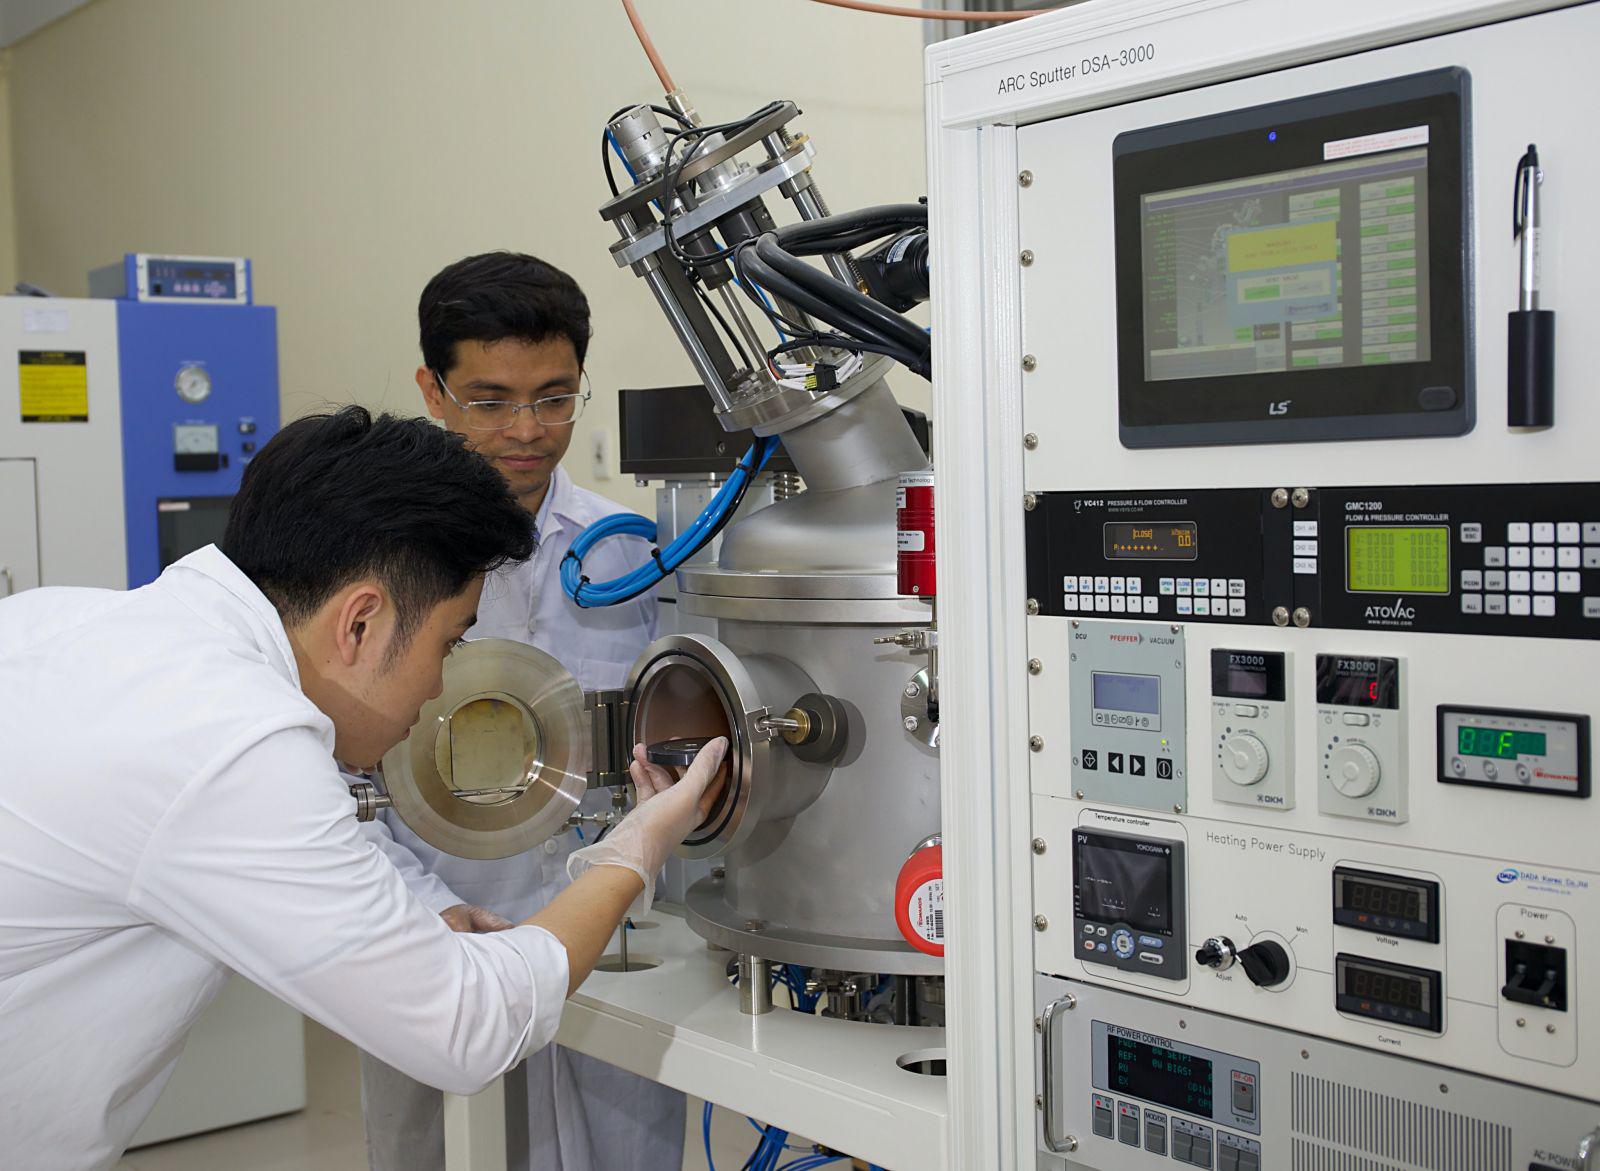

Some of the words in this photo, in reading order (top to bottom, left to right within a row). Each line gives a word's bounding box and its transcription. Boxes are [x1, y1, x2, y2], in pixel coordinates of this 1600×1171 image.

[997, 75, 1026, 95] ARC
[1030, 64, 1077, 87] Sputter
[1081, 43, 1155, 75] DSA-3000
[1269, 400, 1291, 415] LS
[1344, 501, 1383, 511] GMC1200
[1405, 513, 1449, 521] CONTROLLER
[1365, 598, 1416, 620] ATOVAC
[1110, 634, 1138, 643] PFEIFFER
[1150, 637, 1175, 645] VACUUM
[1230, 654, 1265, 666] FX3000
[1337, 660, 1376, 672] FX3000
[1264, 795, 1284, 804] DKM
[1376, 808, 1396, 817] DKM
[1094, 812, 1126, 824] Temperature
[1126, 818, 1150, 826] controller
[1077, 834, 1088, 844] PV
[1136, 843, 1164, 854] YOKOGAWA
[1206, 831, 1246, 850] Heating
[1251, 837, 1284, 852] Power
[1288, 843, 1326, 862] Supply
[1520, 872, 1539, 880] DADA
[1234, 914, 1248, 922] Auto
[1520, 908, 1548, 920] Power
[1376, 936, 1399, 946] Voltage
[1216, 972, 1233, 981] Adjust
[1106, 1025, 1116, 1034] RF
[1116, 1027, 1140, 1040] POWER
[1142, 1034, 1174, 1050] CONTROL
[1378, 1035, 1402, 1046] Current
[1118, 1050, 1137, 1062] REF:
[1534, 1149, 1546, 1161] AC
[1548, 1152, 1578, 1168] POWE
